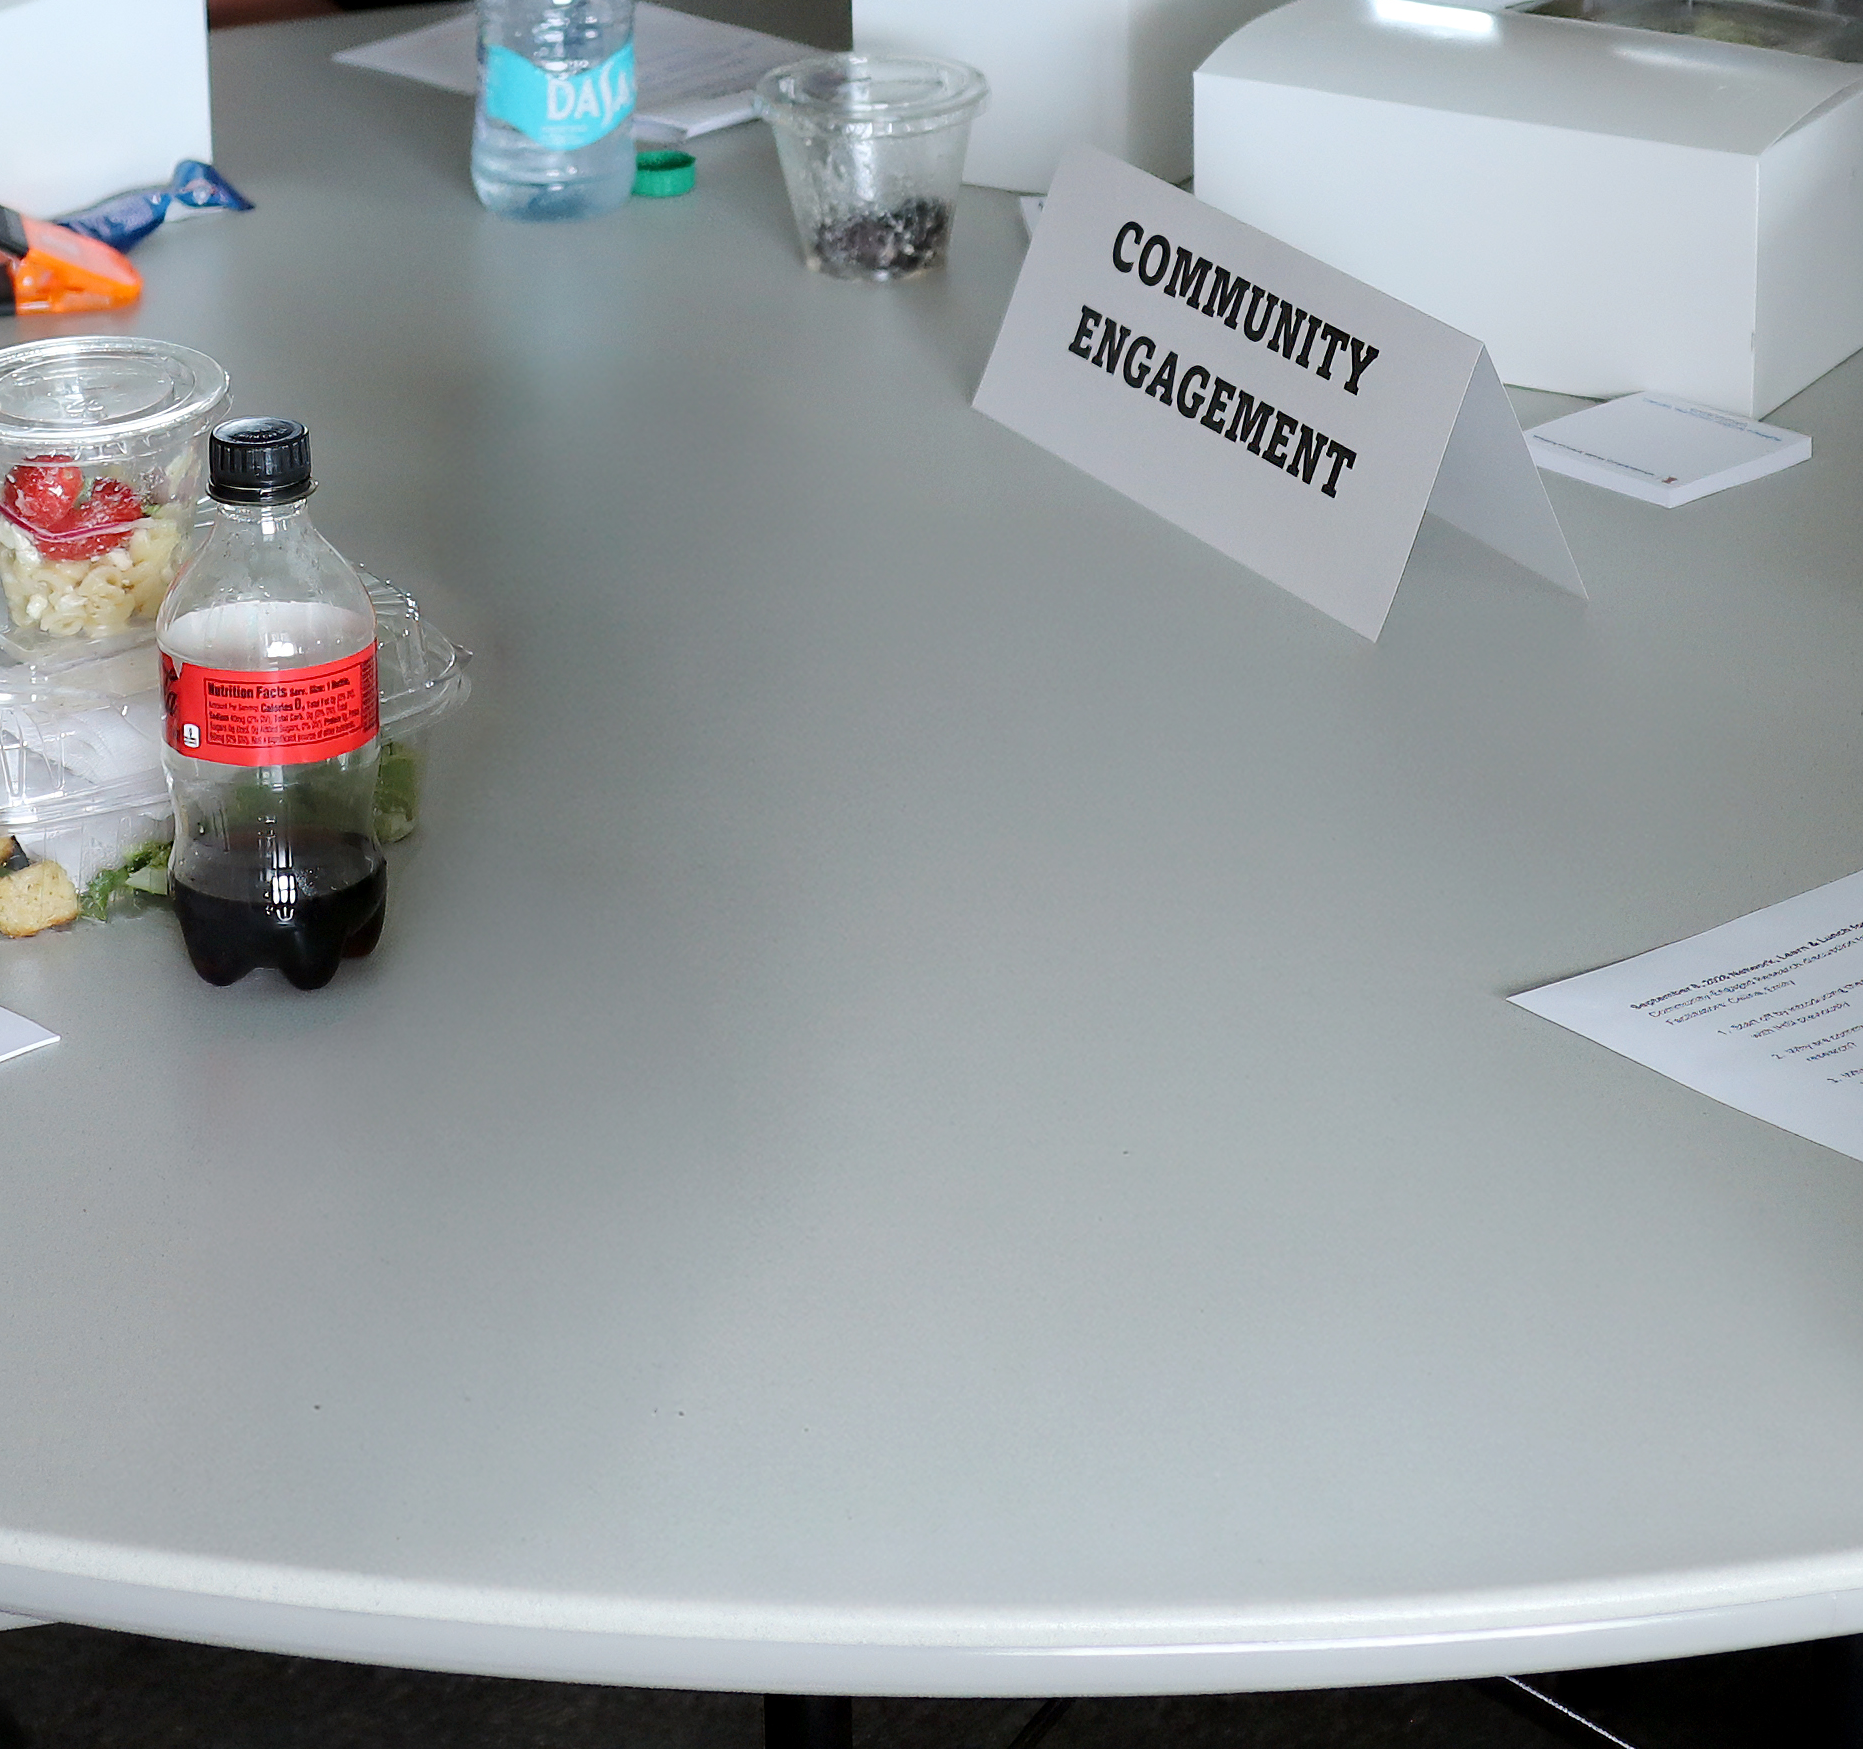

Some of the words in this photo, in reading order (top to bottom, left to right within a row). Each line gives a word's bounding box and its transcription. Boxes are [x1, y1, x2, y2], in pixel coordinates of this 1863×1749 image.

[1112, 221, 1379, 396] COMMUNITY
[1069, 305, 1356, 498] ENGAGEMENT
[208, 682, 253, 698] Nutrition
[256, 685, 287, 699] Facts
